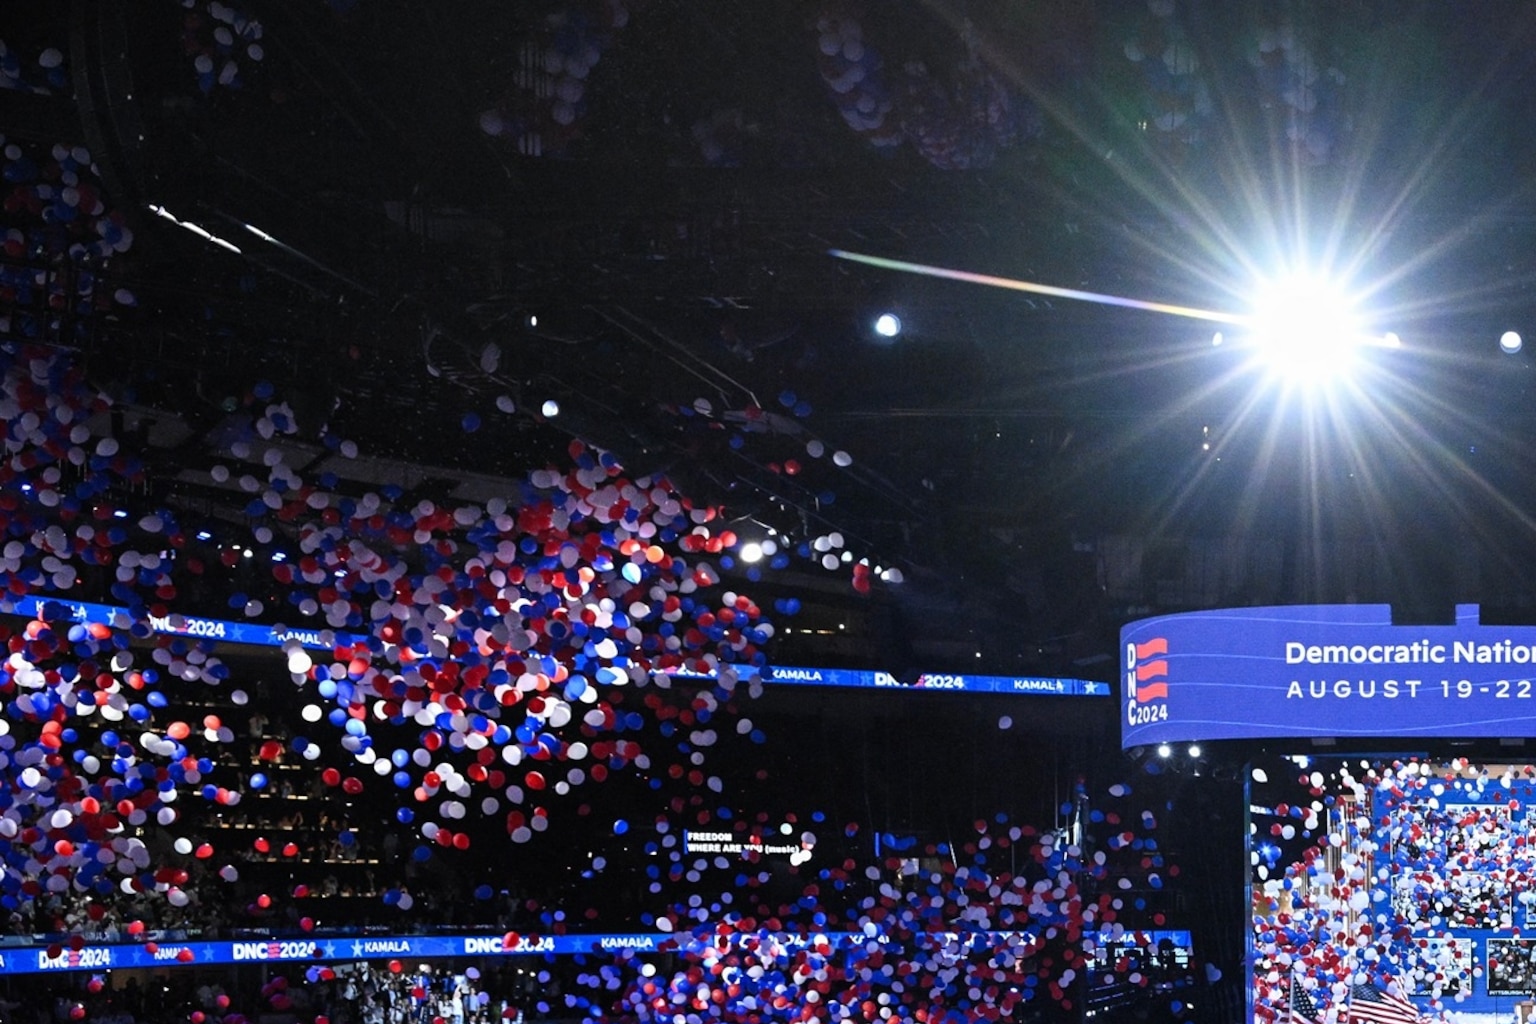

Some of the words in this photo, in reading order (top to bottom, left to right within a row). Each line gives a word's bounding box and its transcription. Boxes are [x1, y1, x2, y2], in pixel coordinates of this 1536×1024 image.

[187, 620, 225, 637] 2024
[1286, 642, 1447, 666] Democratic
[925, 675, 964, 689] 2024
[1014, 680, 1064, 691] KAMALA
[1287, 680, 1422, 699] AUGUST
[1442, 680, 1534, 699] 19-22
[1137, 705, 1168, 722] 2024
[687, 832, 733, 841] FREEDOM
[687, 843, 721, 853] WHERE
[722, 844, 742, 853] ARE
[765, 845, 800, 855] (music)
[364, 941, 410, 953] KAMALA
[601, 935, 653, 948] KAMALA
[78, 949, 110, 966] 2024
[232, 943, 268, 960] DNC
[280, 942, 316, 958] 2024
